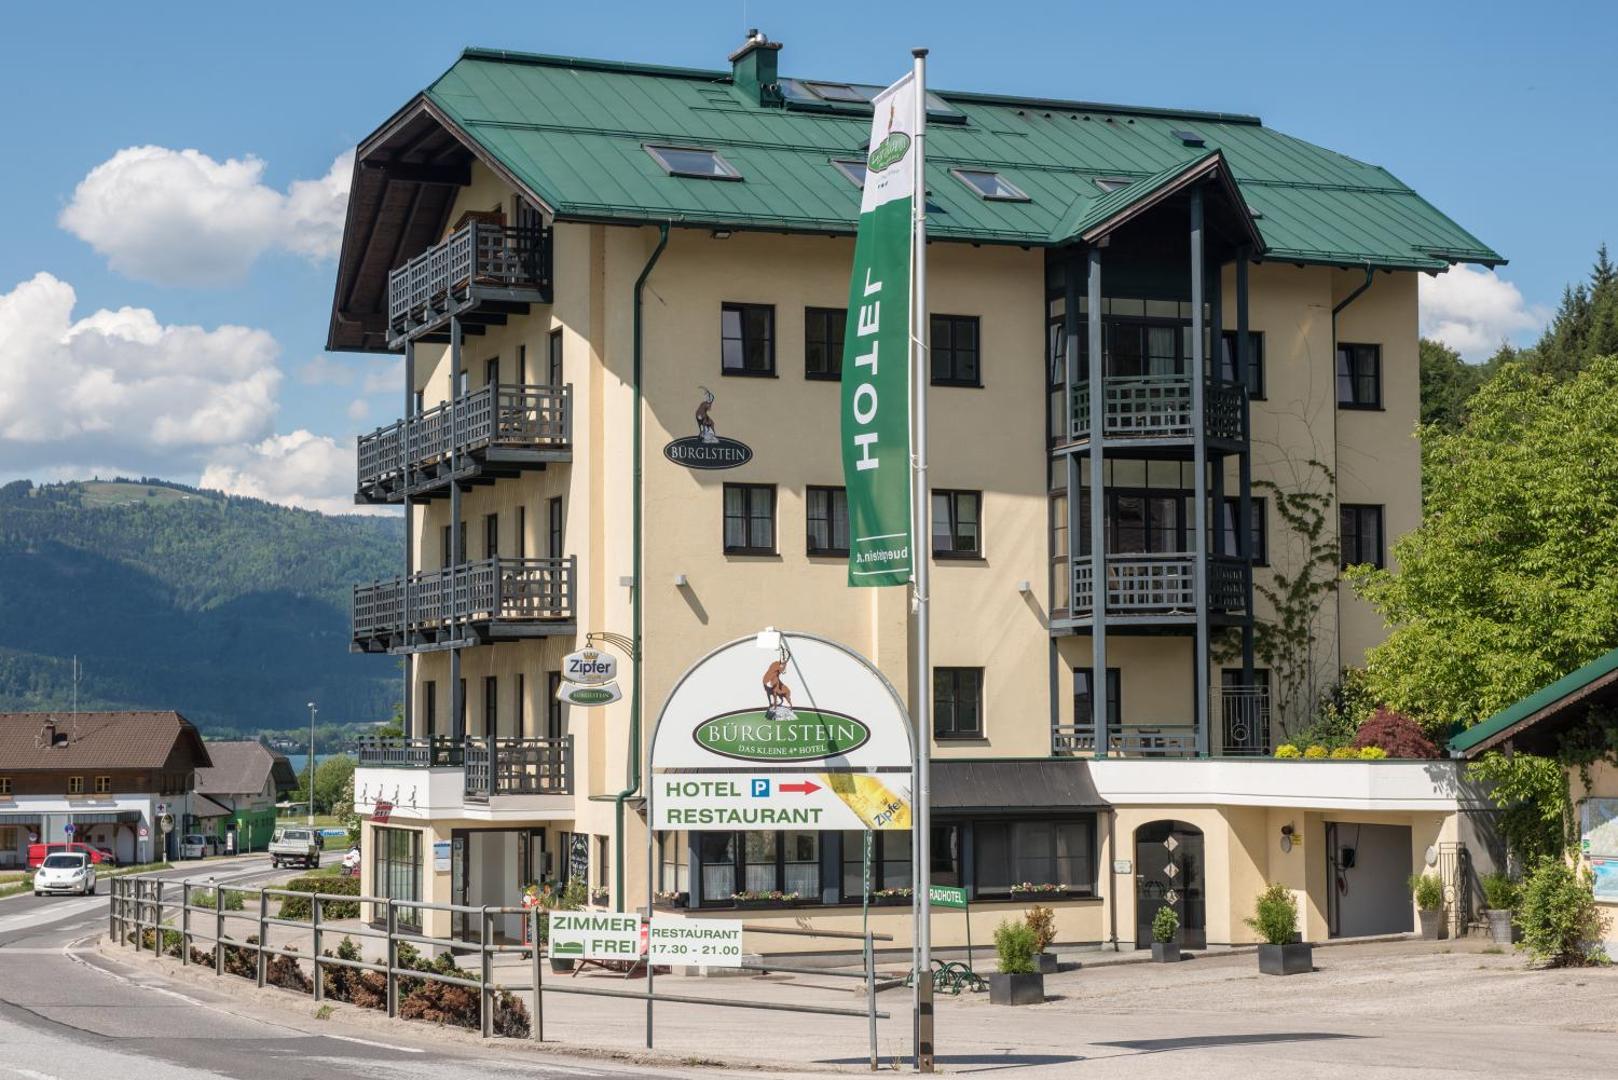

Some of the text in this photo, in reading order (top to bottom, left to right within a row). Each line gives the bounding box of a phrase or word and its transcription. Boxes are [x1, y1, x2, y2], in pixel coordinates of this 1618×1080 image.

[671, 444, 745, 460] BÜRGLSTEIN
[569, 659, 611, 675] Zipfer
[708, 722, 856, 742] BÜRGLSTEIN
[738, 744, 756, 754] DAS
[756, 746, 788, 755] KLEINE
[799, 744, 826, 754] HOTEL
[666, 780, 767, 797] HOTEL P
[667, 808, 823, 824] RESTAURANT
[929, 888, 964, 904] RADHOTEL
[553, 916, 637, 931] ZIMMER
[651, 928, 740, 939] RESTAURANT
[592, 939, 636, 954] FREI
[651, 944, 688, 954] 17.30
[702, 945, 739, 956] 21.00
